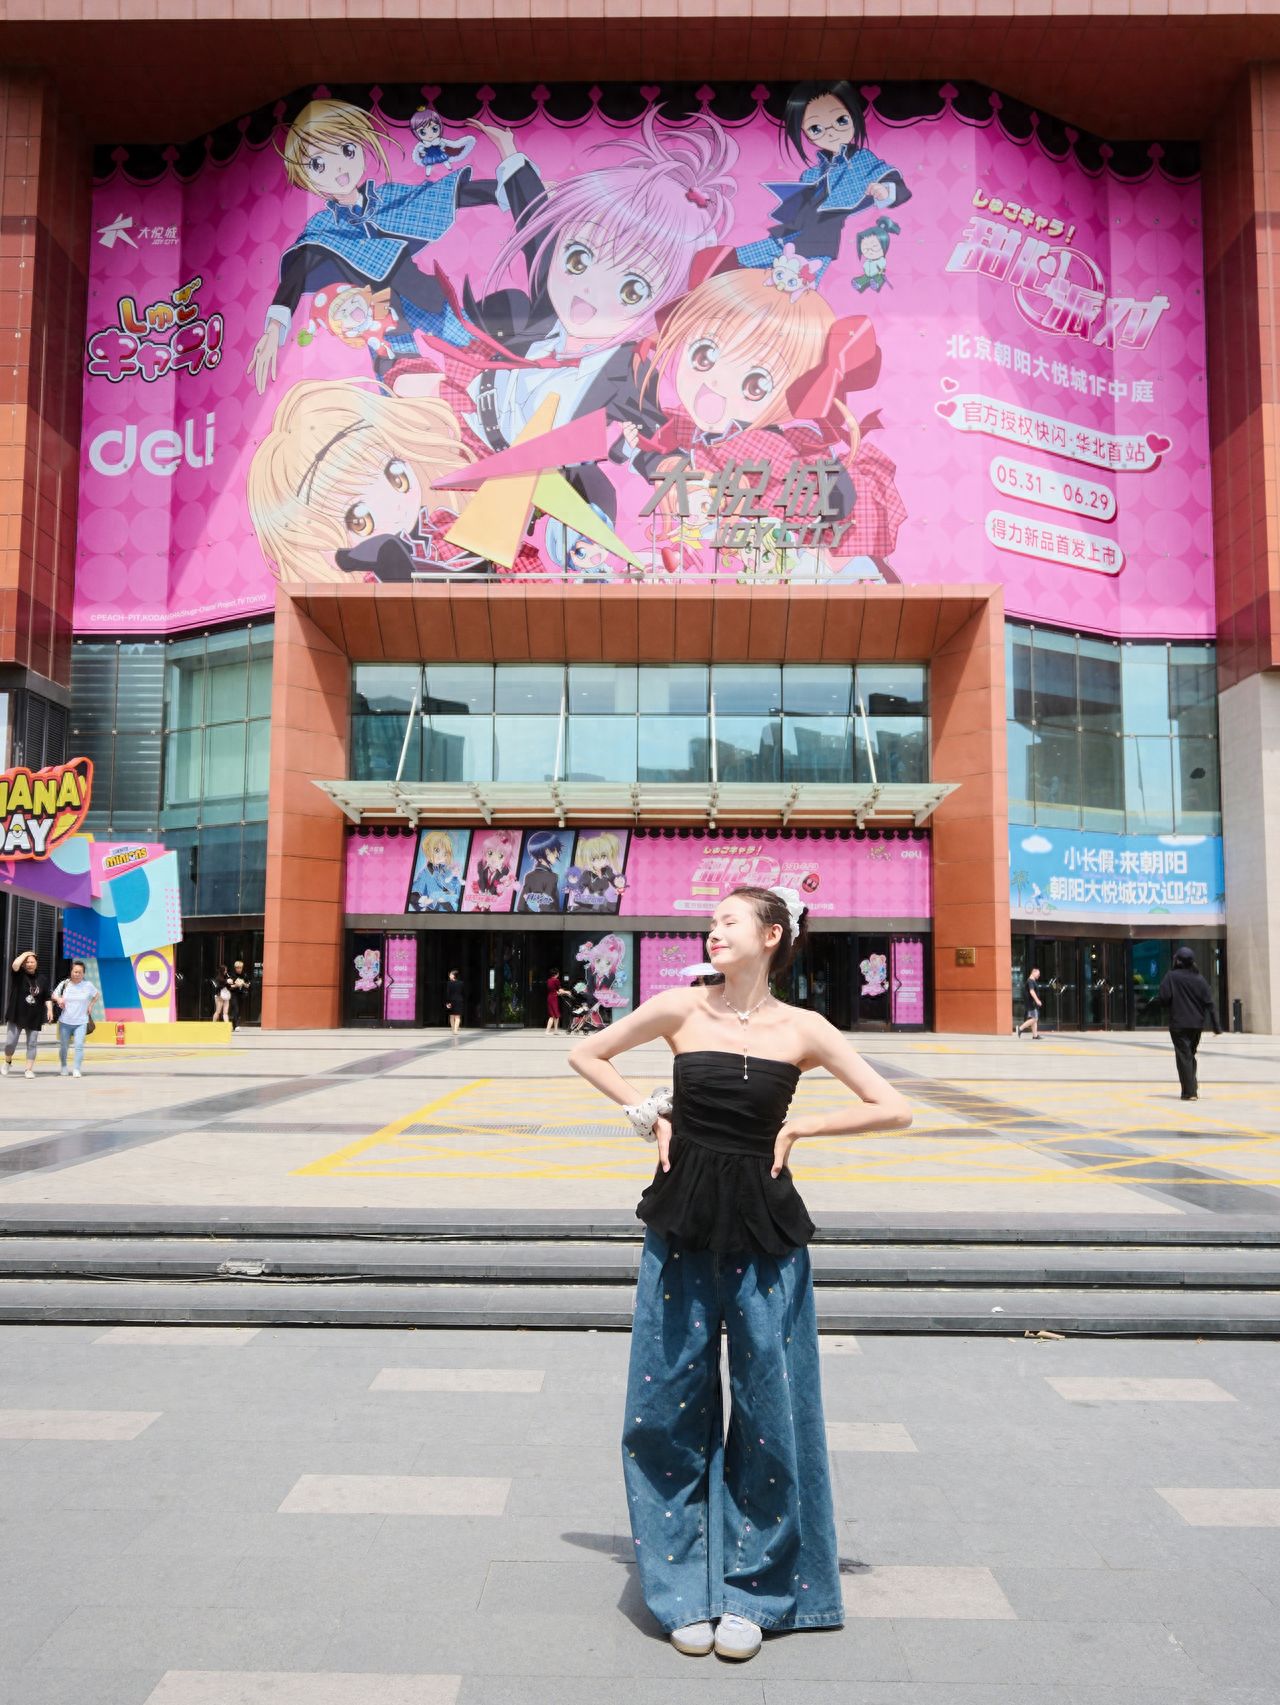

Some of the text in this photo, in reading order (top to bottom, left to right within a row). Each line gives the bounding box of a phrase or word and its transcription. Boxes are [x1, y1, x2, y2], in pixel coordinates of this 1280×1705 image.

[137, 226, 178, 239] 大悦城
[946, 335, 1154, 403] 北京朝阳大悦城1F中庭
[88, 412, 216, 476] deli
[639, 458, 841, 517] 大悦城
[997, 464, 1042, 493] 05.31
[1063, 484, 1109, 511] 06.29
[710, 522, 854, 548] JOY CITY
[991, 517, 1116, 567] 得力新品首发上市
[0, 813, 54, 852] AY
[1050, 875, 1208, 905] 朝阳大悦城欢迎您
[659, 967, 683, 977] del
